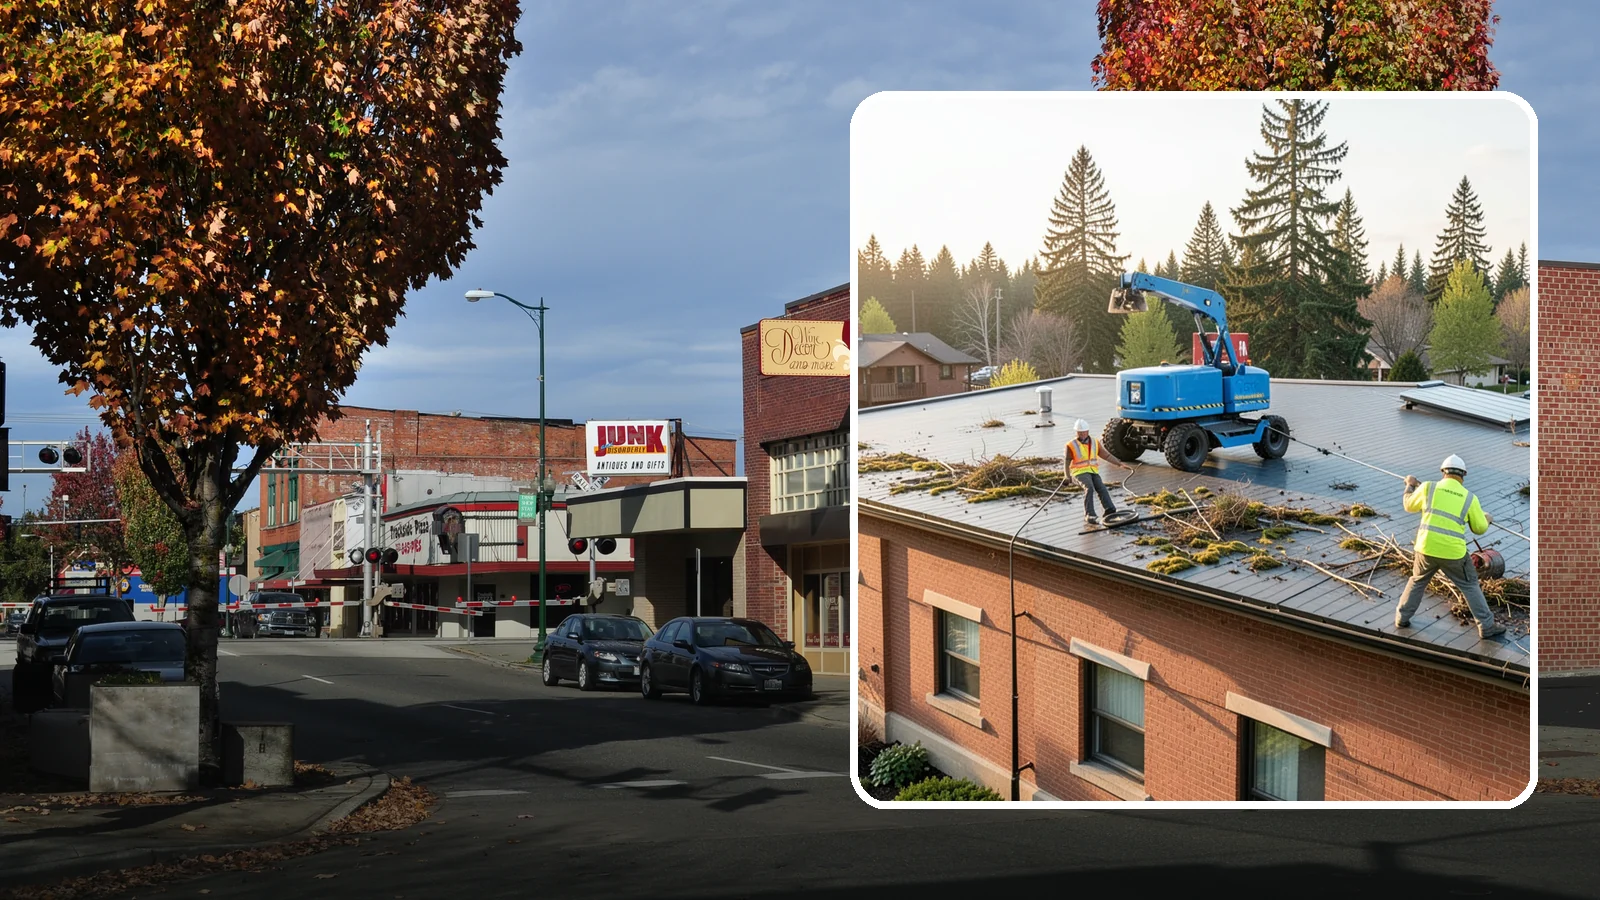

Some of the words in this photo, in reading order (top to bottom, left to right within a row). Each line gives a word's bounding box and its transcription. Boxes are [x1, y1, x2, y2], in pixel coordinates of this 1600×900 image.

[595, 425, 665, 457] JUNK
[597, 461, 628, 470] ANTIQUES
[631, 461, 644, 469] AND
[647, 460, 665, 469] GIFTS
[573, 473, 588, 490] RAIL
[414, 519, 429, 535] Pizza
